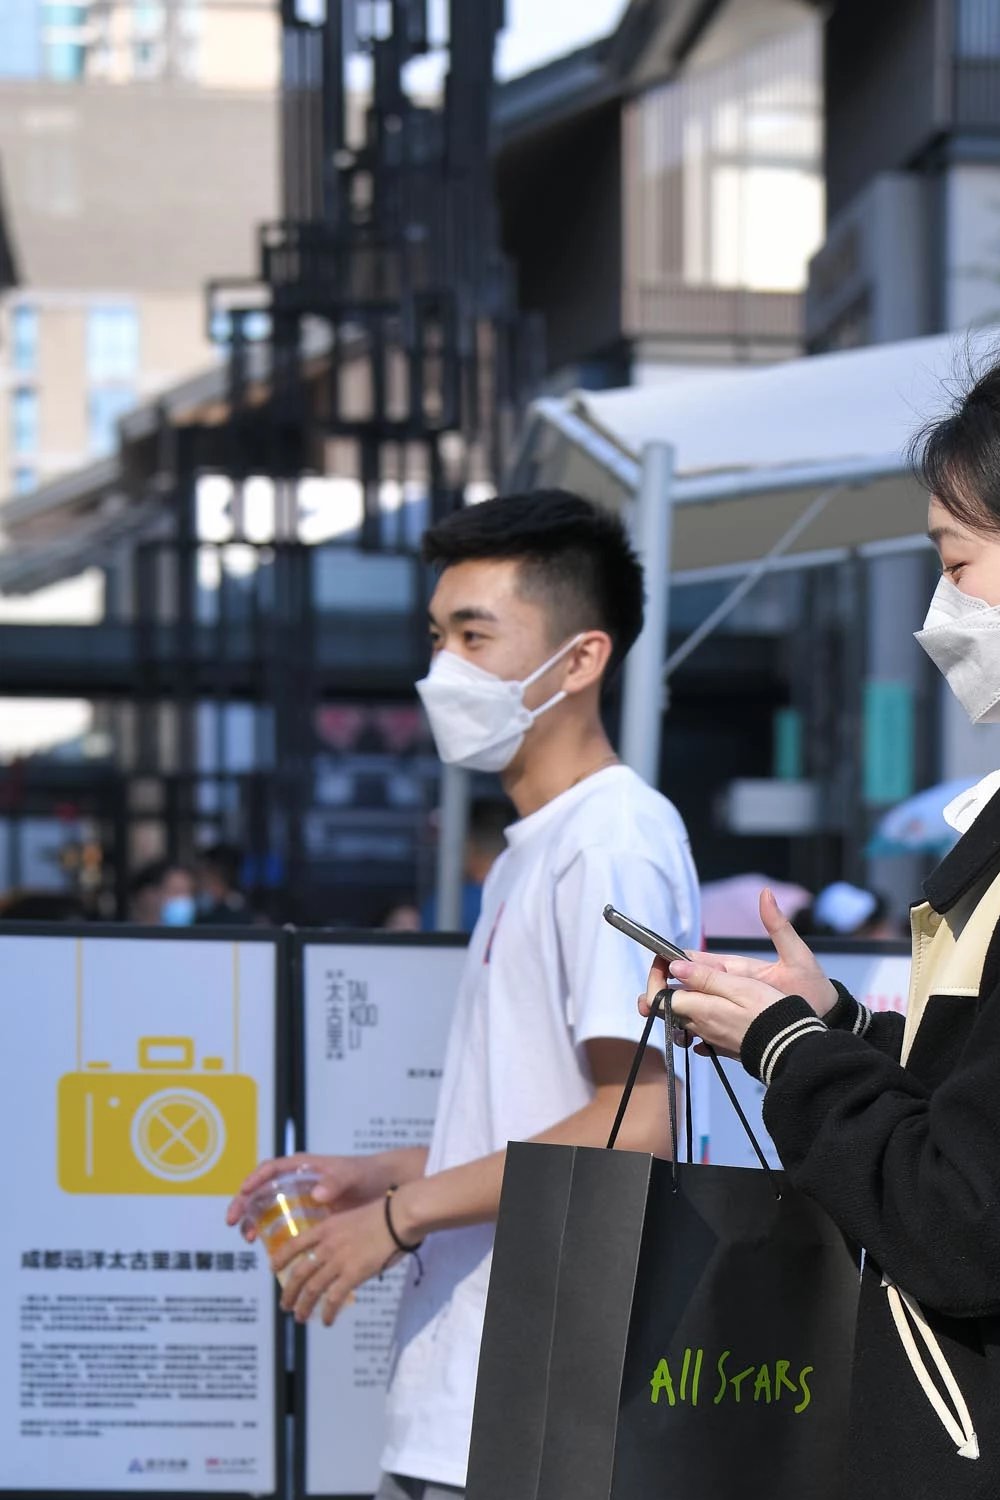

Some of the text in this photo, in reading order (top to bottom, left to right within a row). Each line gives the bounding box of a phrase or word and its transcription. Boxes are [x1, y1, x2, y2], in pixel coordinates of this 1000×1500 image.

[21, 1250, 258, 1271] 成都远洋太古里温馨提示
[714, 1350, 814, 1413] STARS
